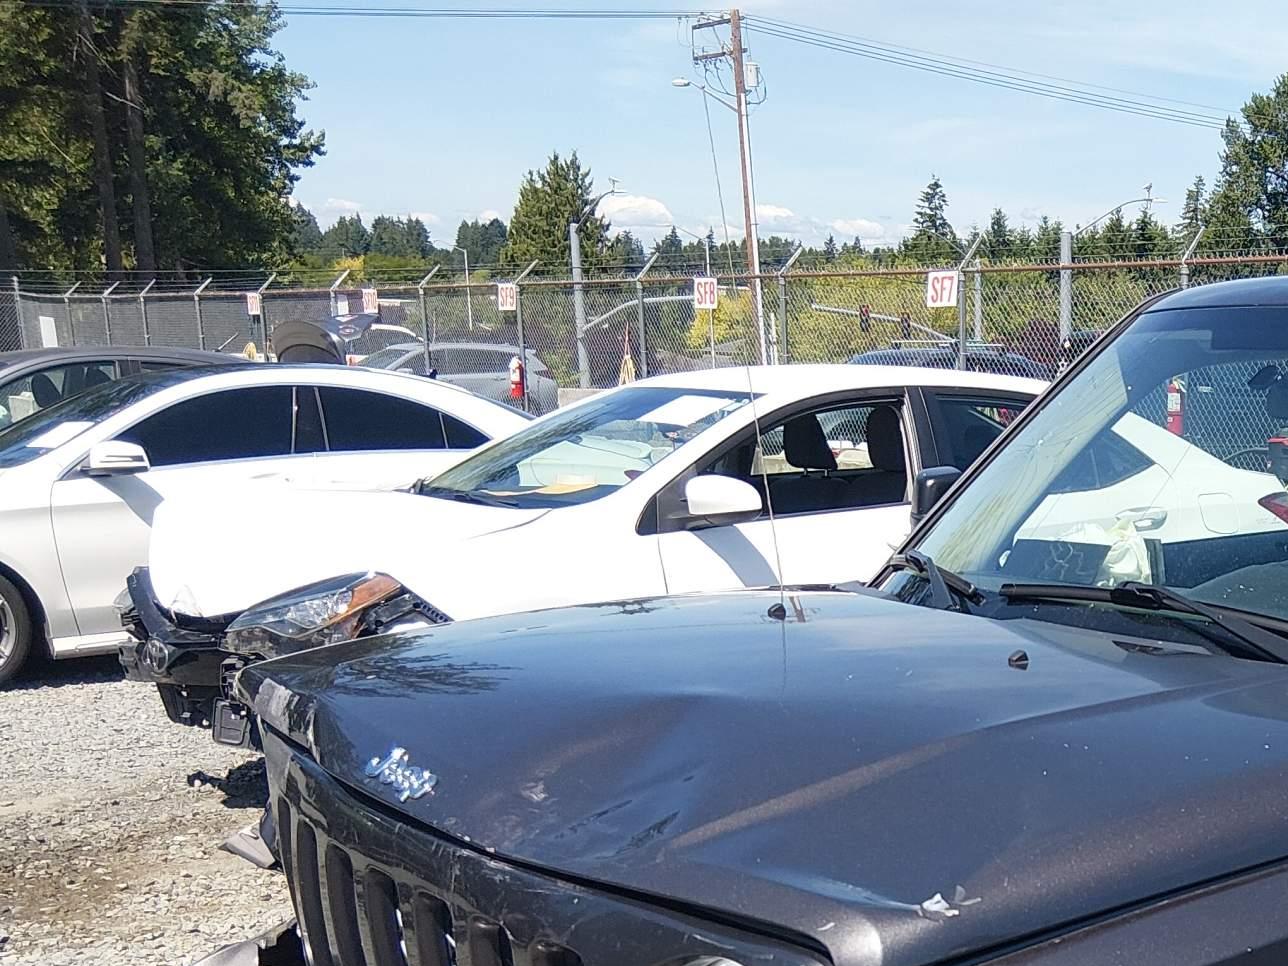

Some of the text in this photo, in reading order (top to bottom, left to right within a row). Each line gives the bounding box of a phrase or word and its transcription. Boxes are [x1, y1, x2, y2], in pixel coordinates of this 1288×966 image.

[500, 286, 515, 307] SF9
[696, 281, 716, 305] SF8
[931, 275, 954, 303] SF7
